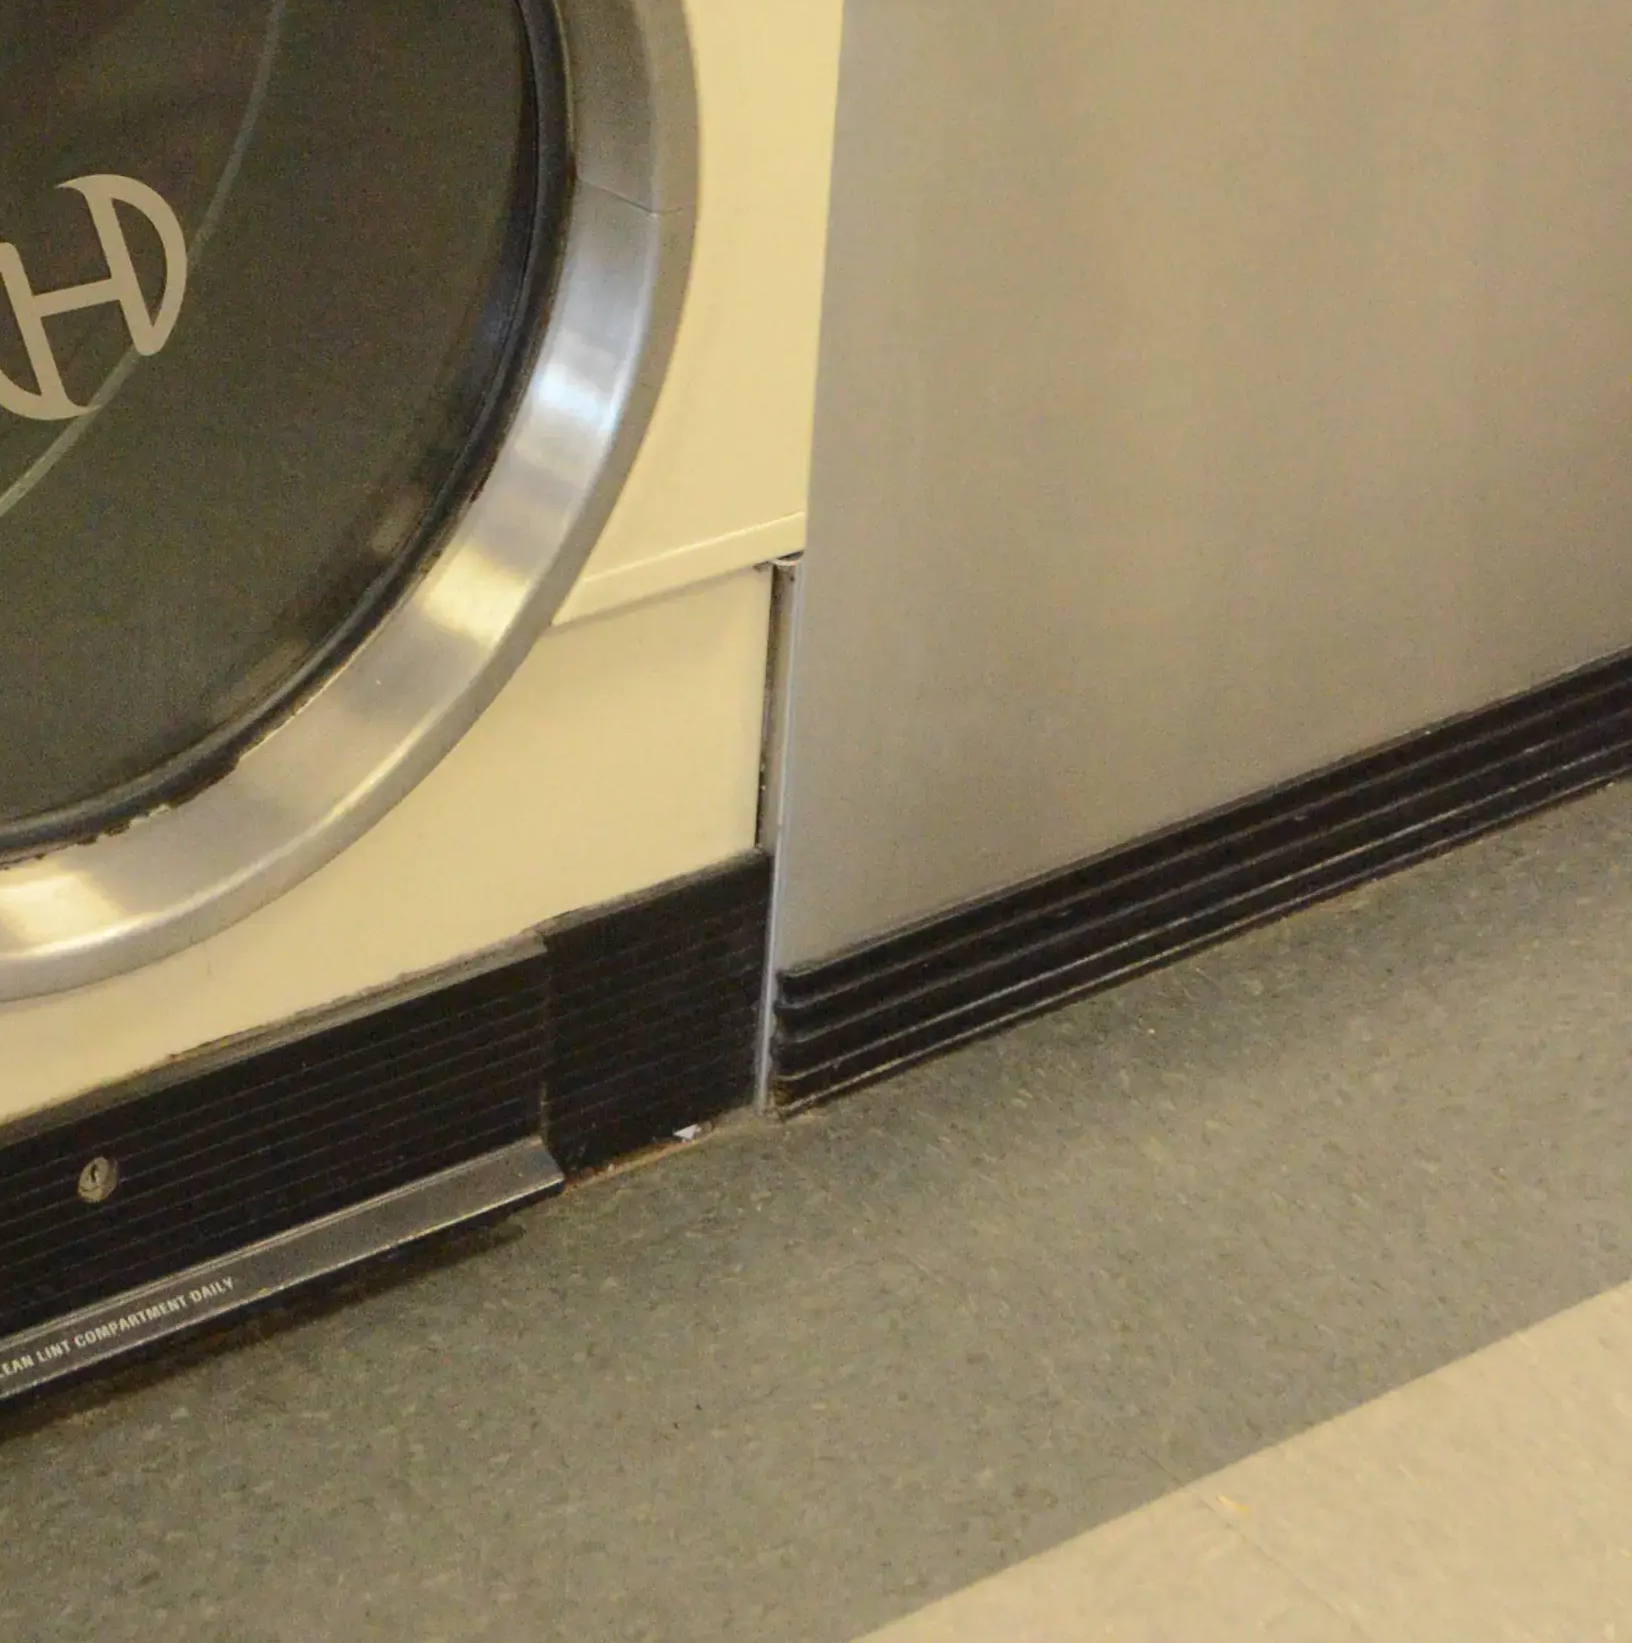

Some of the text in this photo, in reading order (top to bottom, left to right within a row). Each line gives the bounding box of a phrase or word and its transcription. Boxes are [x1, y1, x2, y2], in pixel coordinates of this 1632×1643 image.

[36, 1340, 72, 1364] LINT
[74, 1294, 188, 1349] COMPARTMENT
[188, 1276, 235, 1304] DAILY
